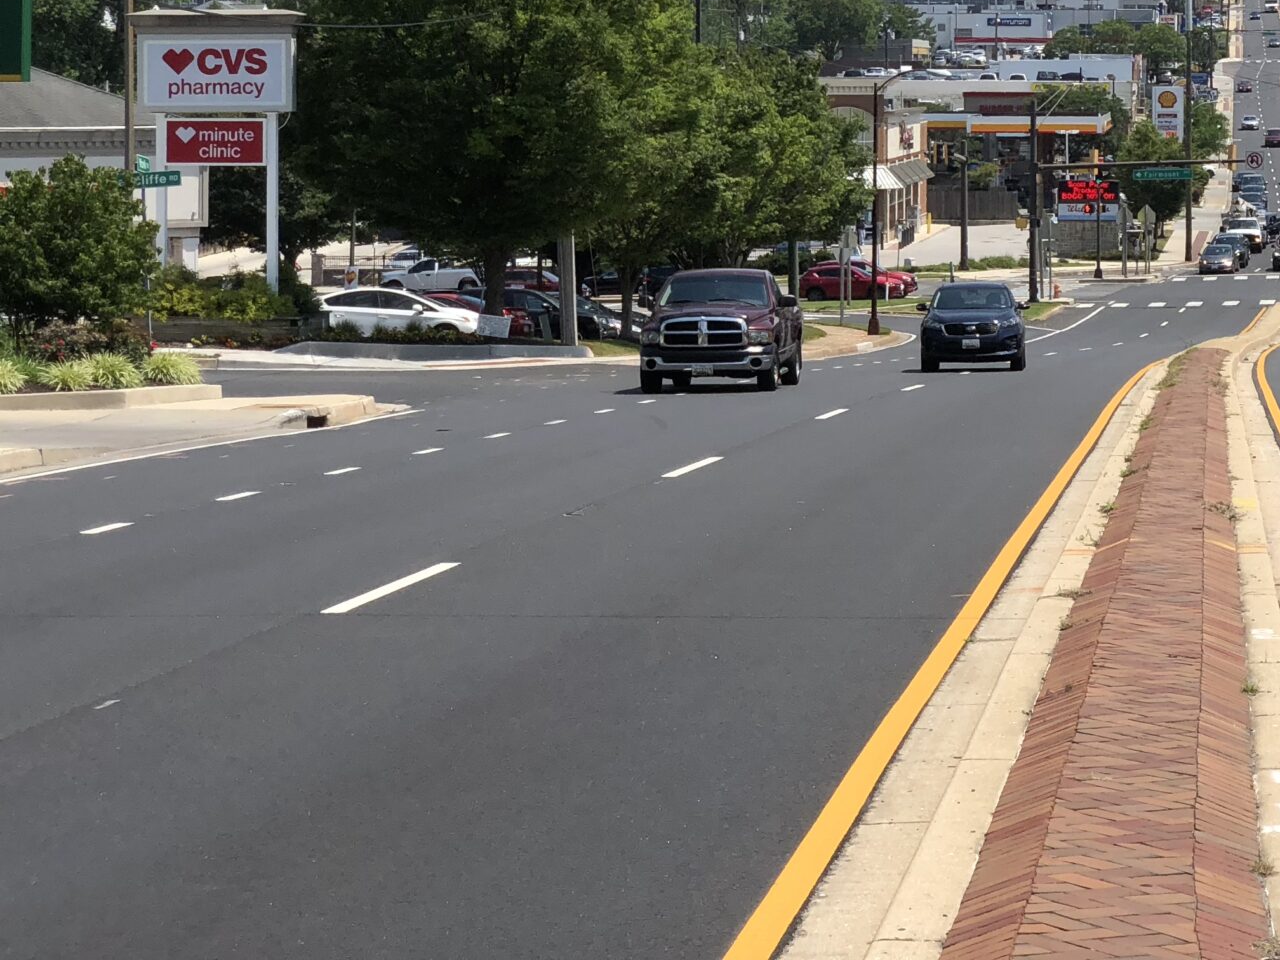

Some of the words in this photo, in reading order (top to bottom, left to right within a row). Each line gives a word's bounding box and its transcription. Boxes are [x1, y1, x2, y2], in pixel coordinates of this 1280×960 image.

[196, 47, 268, 75] CVS
[168, 78, 265, 99] pharmacy
[199, 127, 254, 142] minute
[199, 144, 241, 158] clinic
